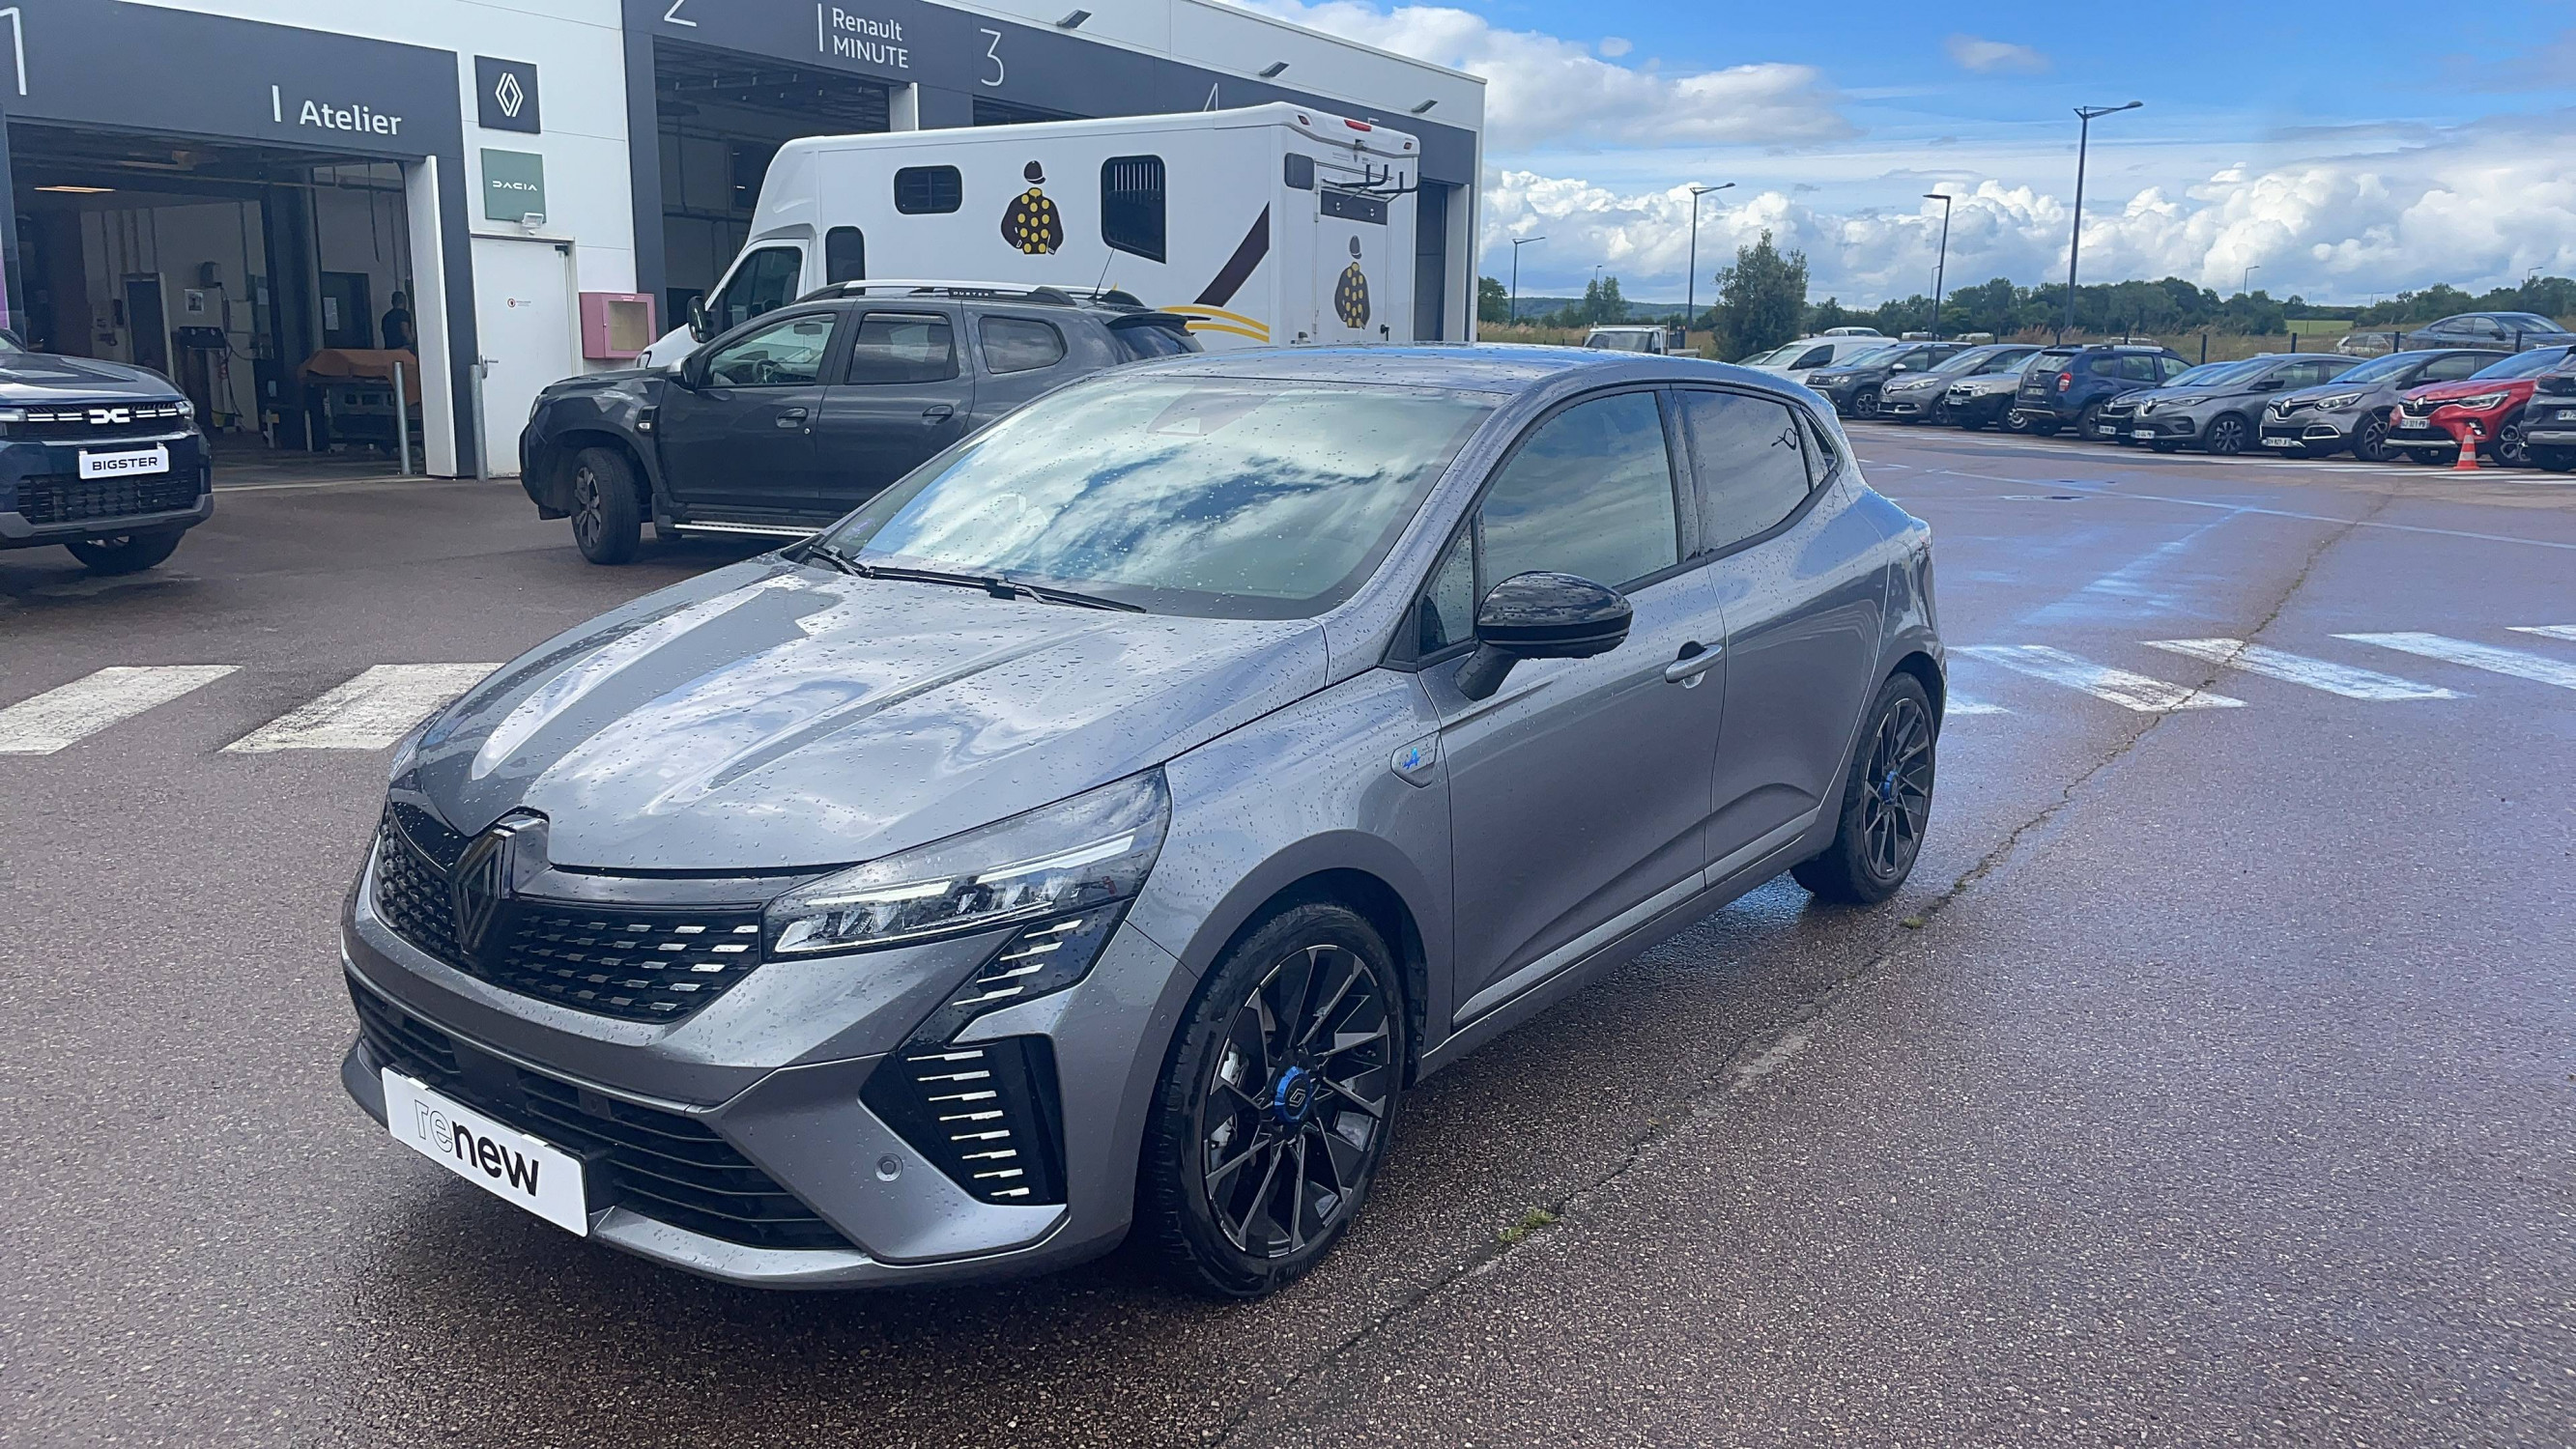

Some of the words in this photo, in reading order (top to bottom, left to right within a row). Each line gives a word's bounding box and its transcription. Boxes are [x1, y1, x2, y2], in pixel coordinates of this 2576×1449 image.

[832, 7, 902, 42] Renault
[833, 35, 909, 69] MINUTE
[980, 27, 1005, 87] 3
[299, 99, 403, 135] Atelier
[492, 180, 538, 191] DACIA
[92, 456, 158, 471] BIGSTER
[414, 1098, 540, 1198] renew
